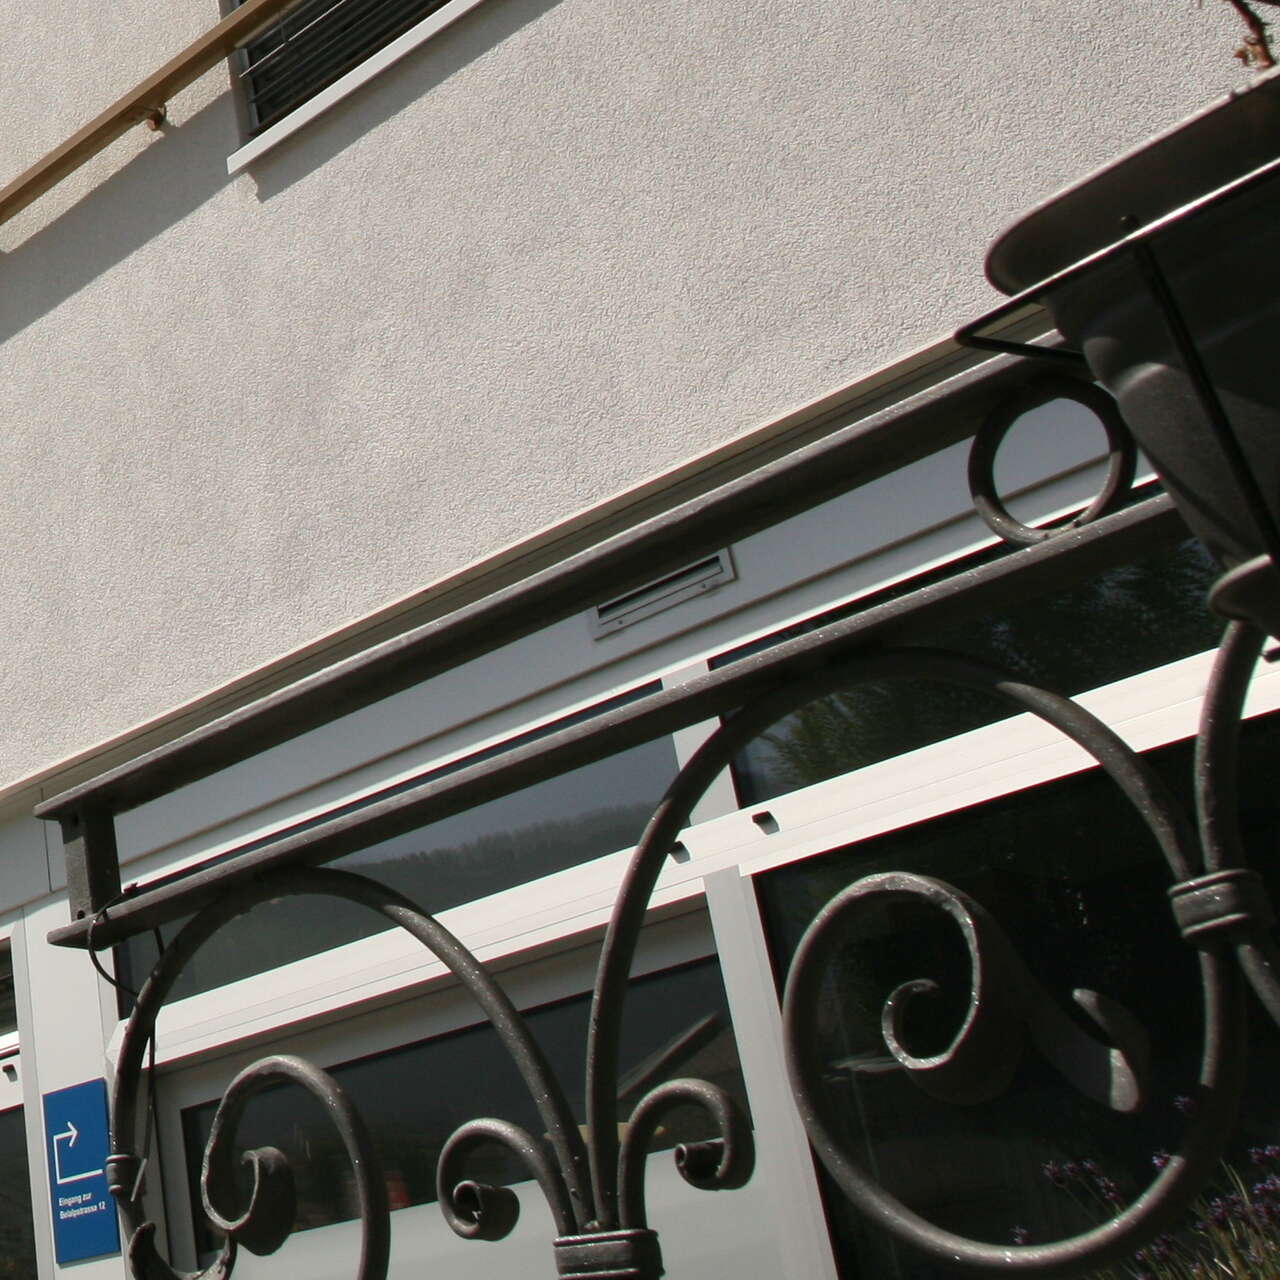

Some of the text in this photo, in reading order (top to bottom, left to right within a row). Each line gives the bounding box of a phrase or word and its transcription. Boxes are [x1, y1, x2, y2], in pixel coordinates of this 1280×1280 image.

[59, 1193, 92, 1206] Eingang zur
[98, 1201, 106, 1209] 12
